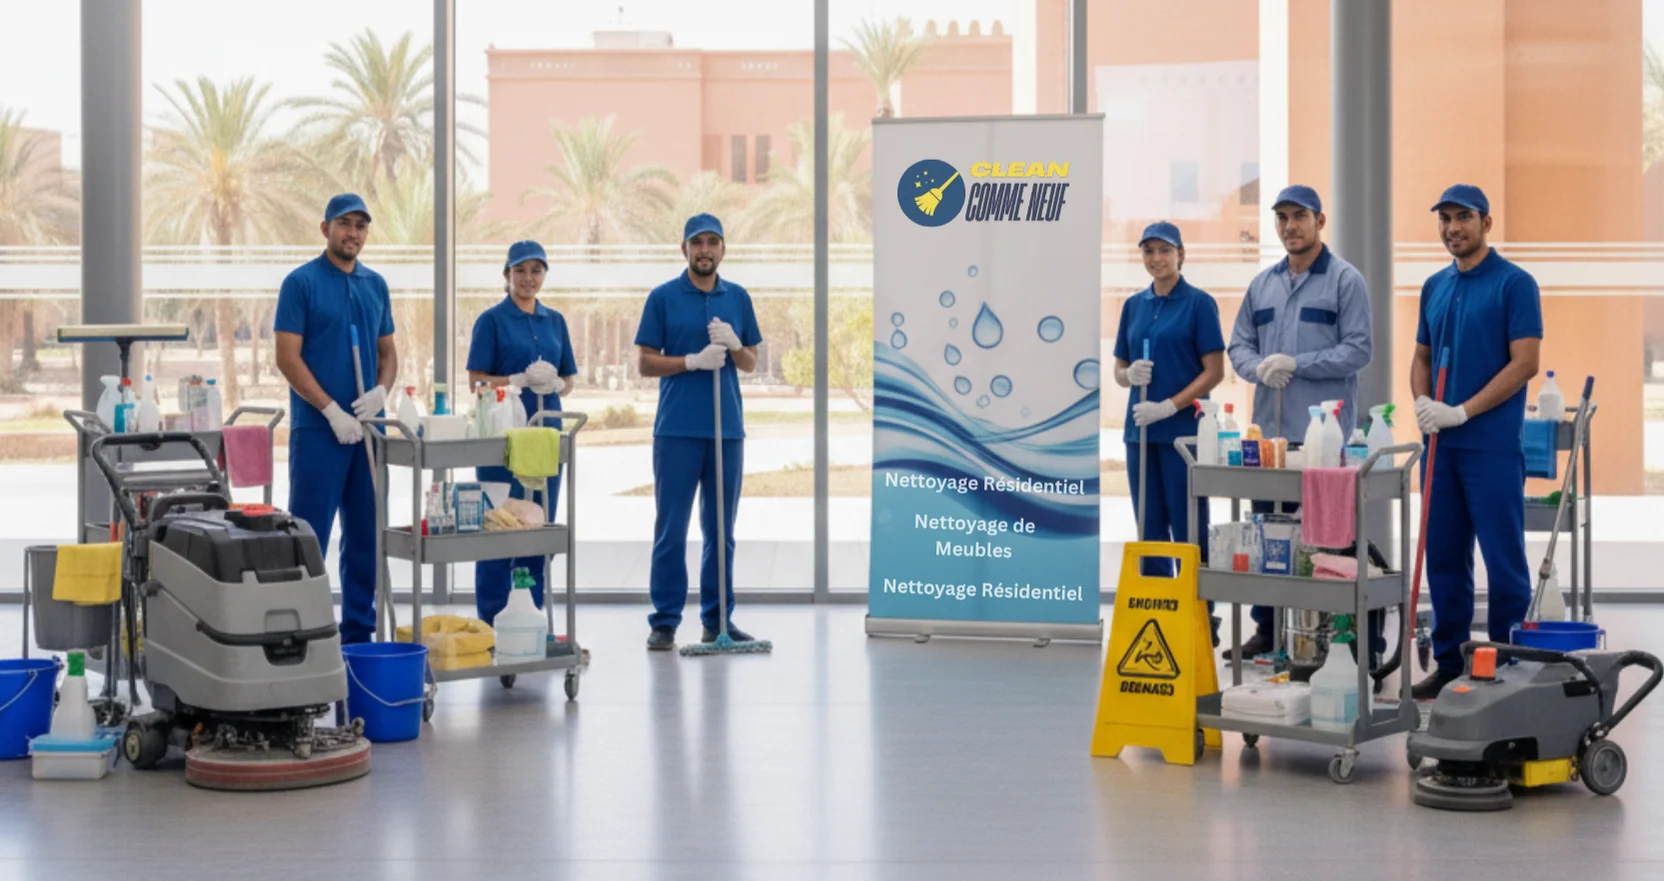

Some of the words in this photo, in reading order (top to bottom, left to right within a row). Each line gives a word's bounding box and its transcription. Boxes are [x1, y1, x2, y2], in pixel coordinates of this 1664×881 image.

[970, 161, 1070, 178] CLEAN
[965, 182, 1028, 222] COMME
[1025, 182, 1070, 222] NEUF
[885, 472, 979, 494] Nettoyage
[983, 476, 1085, 496] Résidentiel
[914, 514, 1008, 536] Nettoyage
[1013, 518, 1036, 534] de
[935, 541, 1012, 559] Meubles
[883, 578, 977, 601] Nettoyage
[982, 582, 1083, 602] Résidentiel
